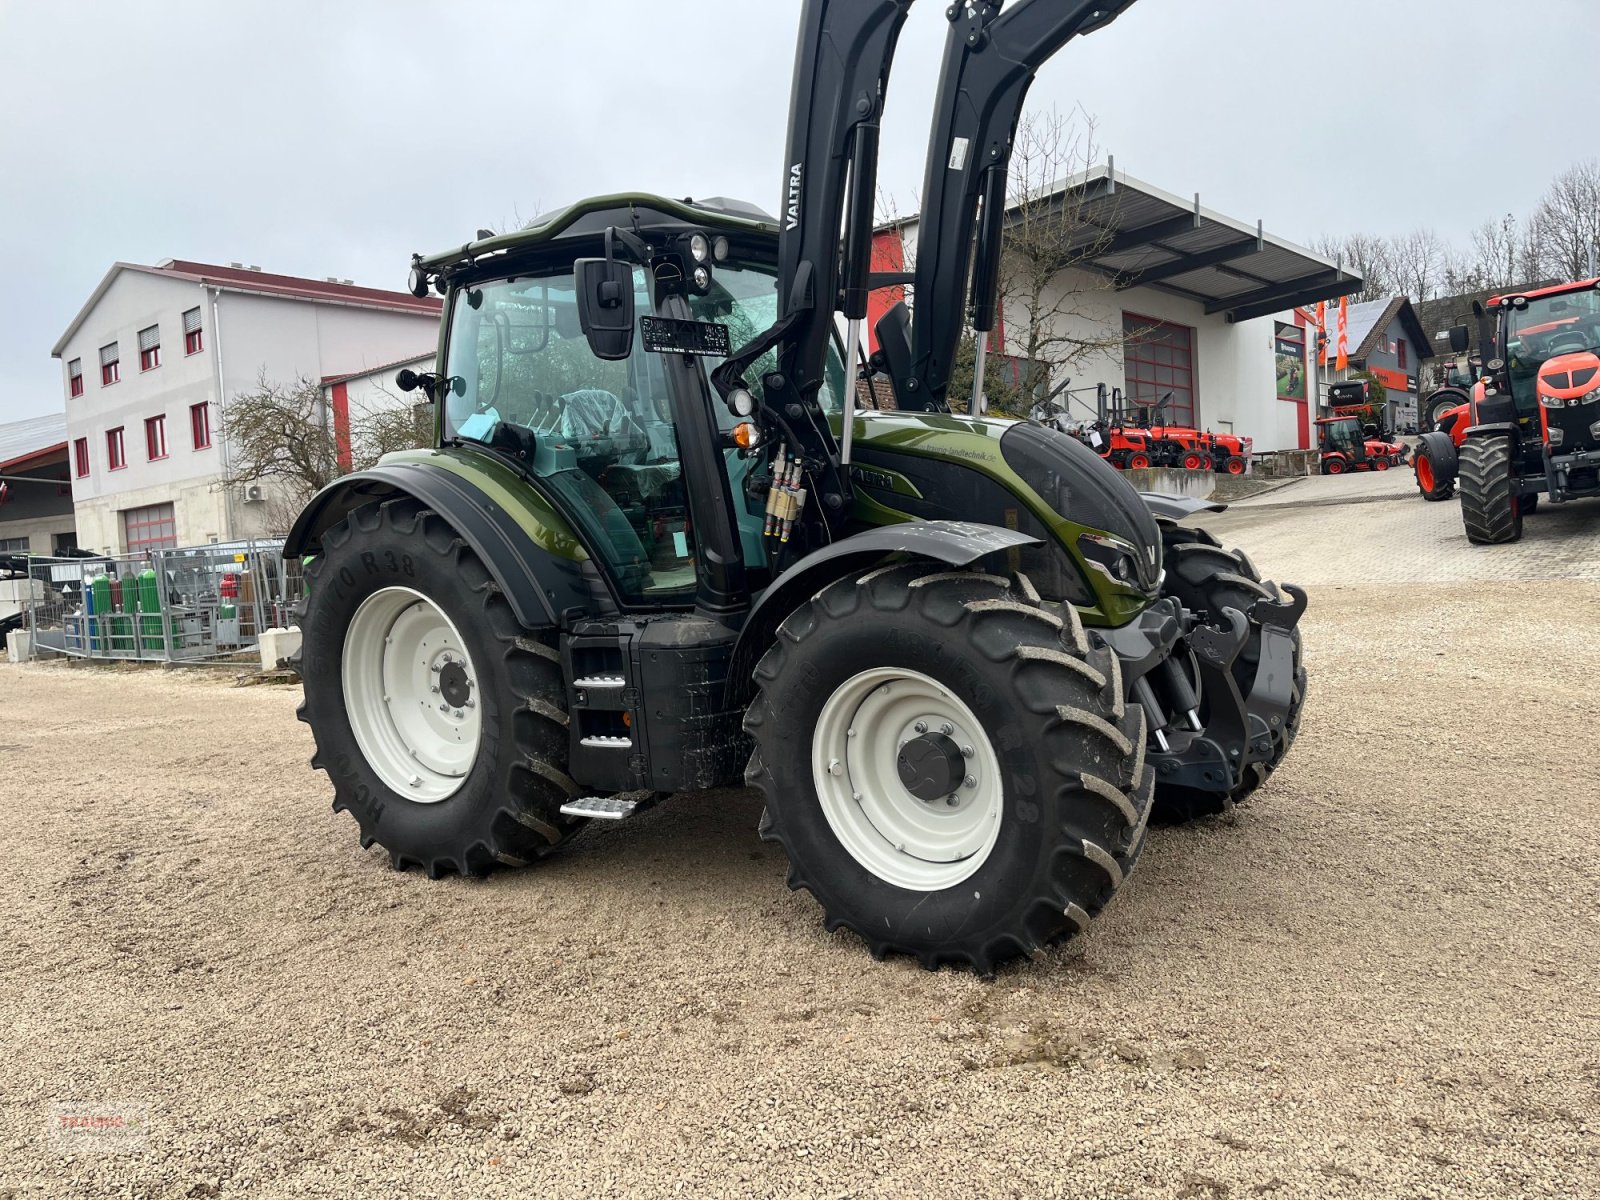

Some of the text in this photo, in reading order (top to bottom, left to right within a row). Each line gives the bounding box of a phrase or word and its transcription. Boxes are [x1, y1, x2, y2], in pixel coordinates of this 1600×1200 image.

[786, 163, 802, 231] VALTRA
[360, 551, 379, 575] R
[384, 550, 415, 578] 38
